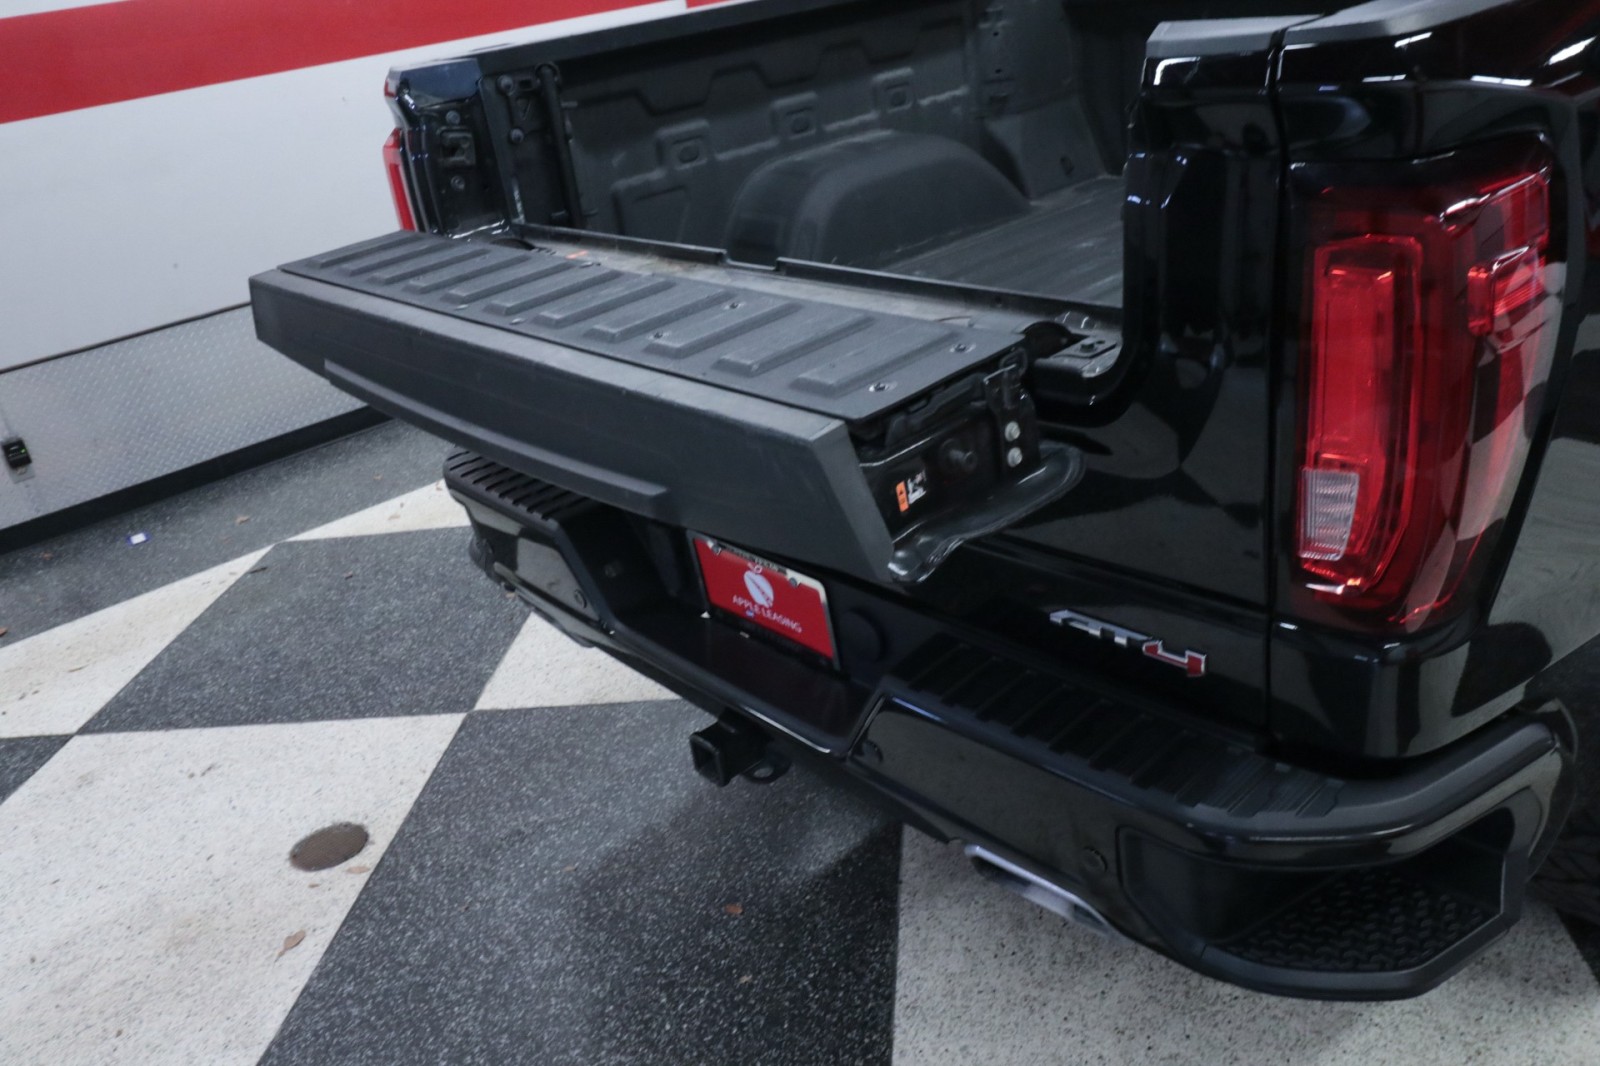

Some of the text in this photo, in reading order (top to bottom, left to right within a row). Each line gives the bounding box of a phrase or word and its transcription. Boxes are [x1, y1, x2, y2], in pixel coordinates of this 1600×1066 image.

[733, 595, 802, 633] APPLE LEASING
[1050, 609, 1207, 677] AT4
